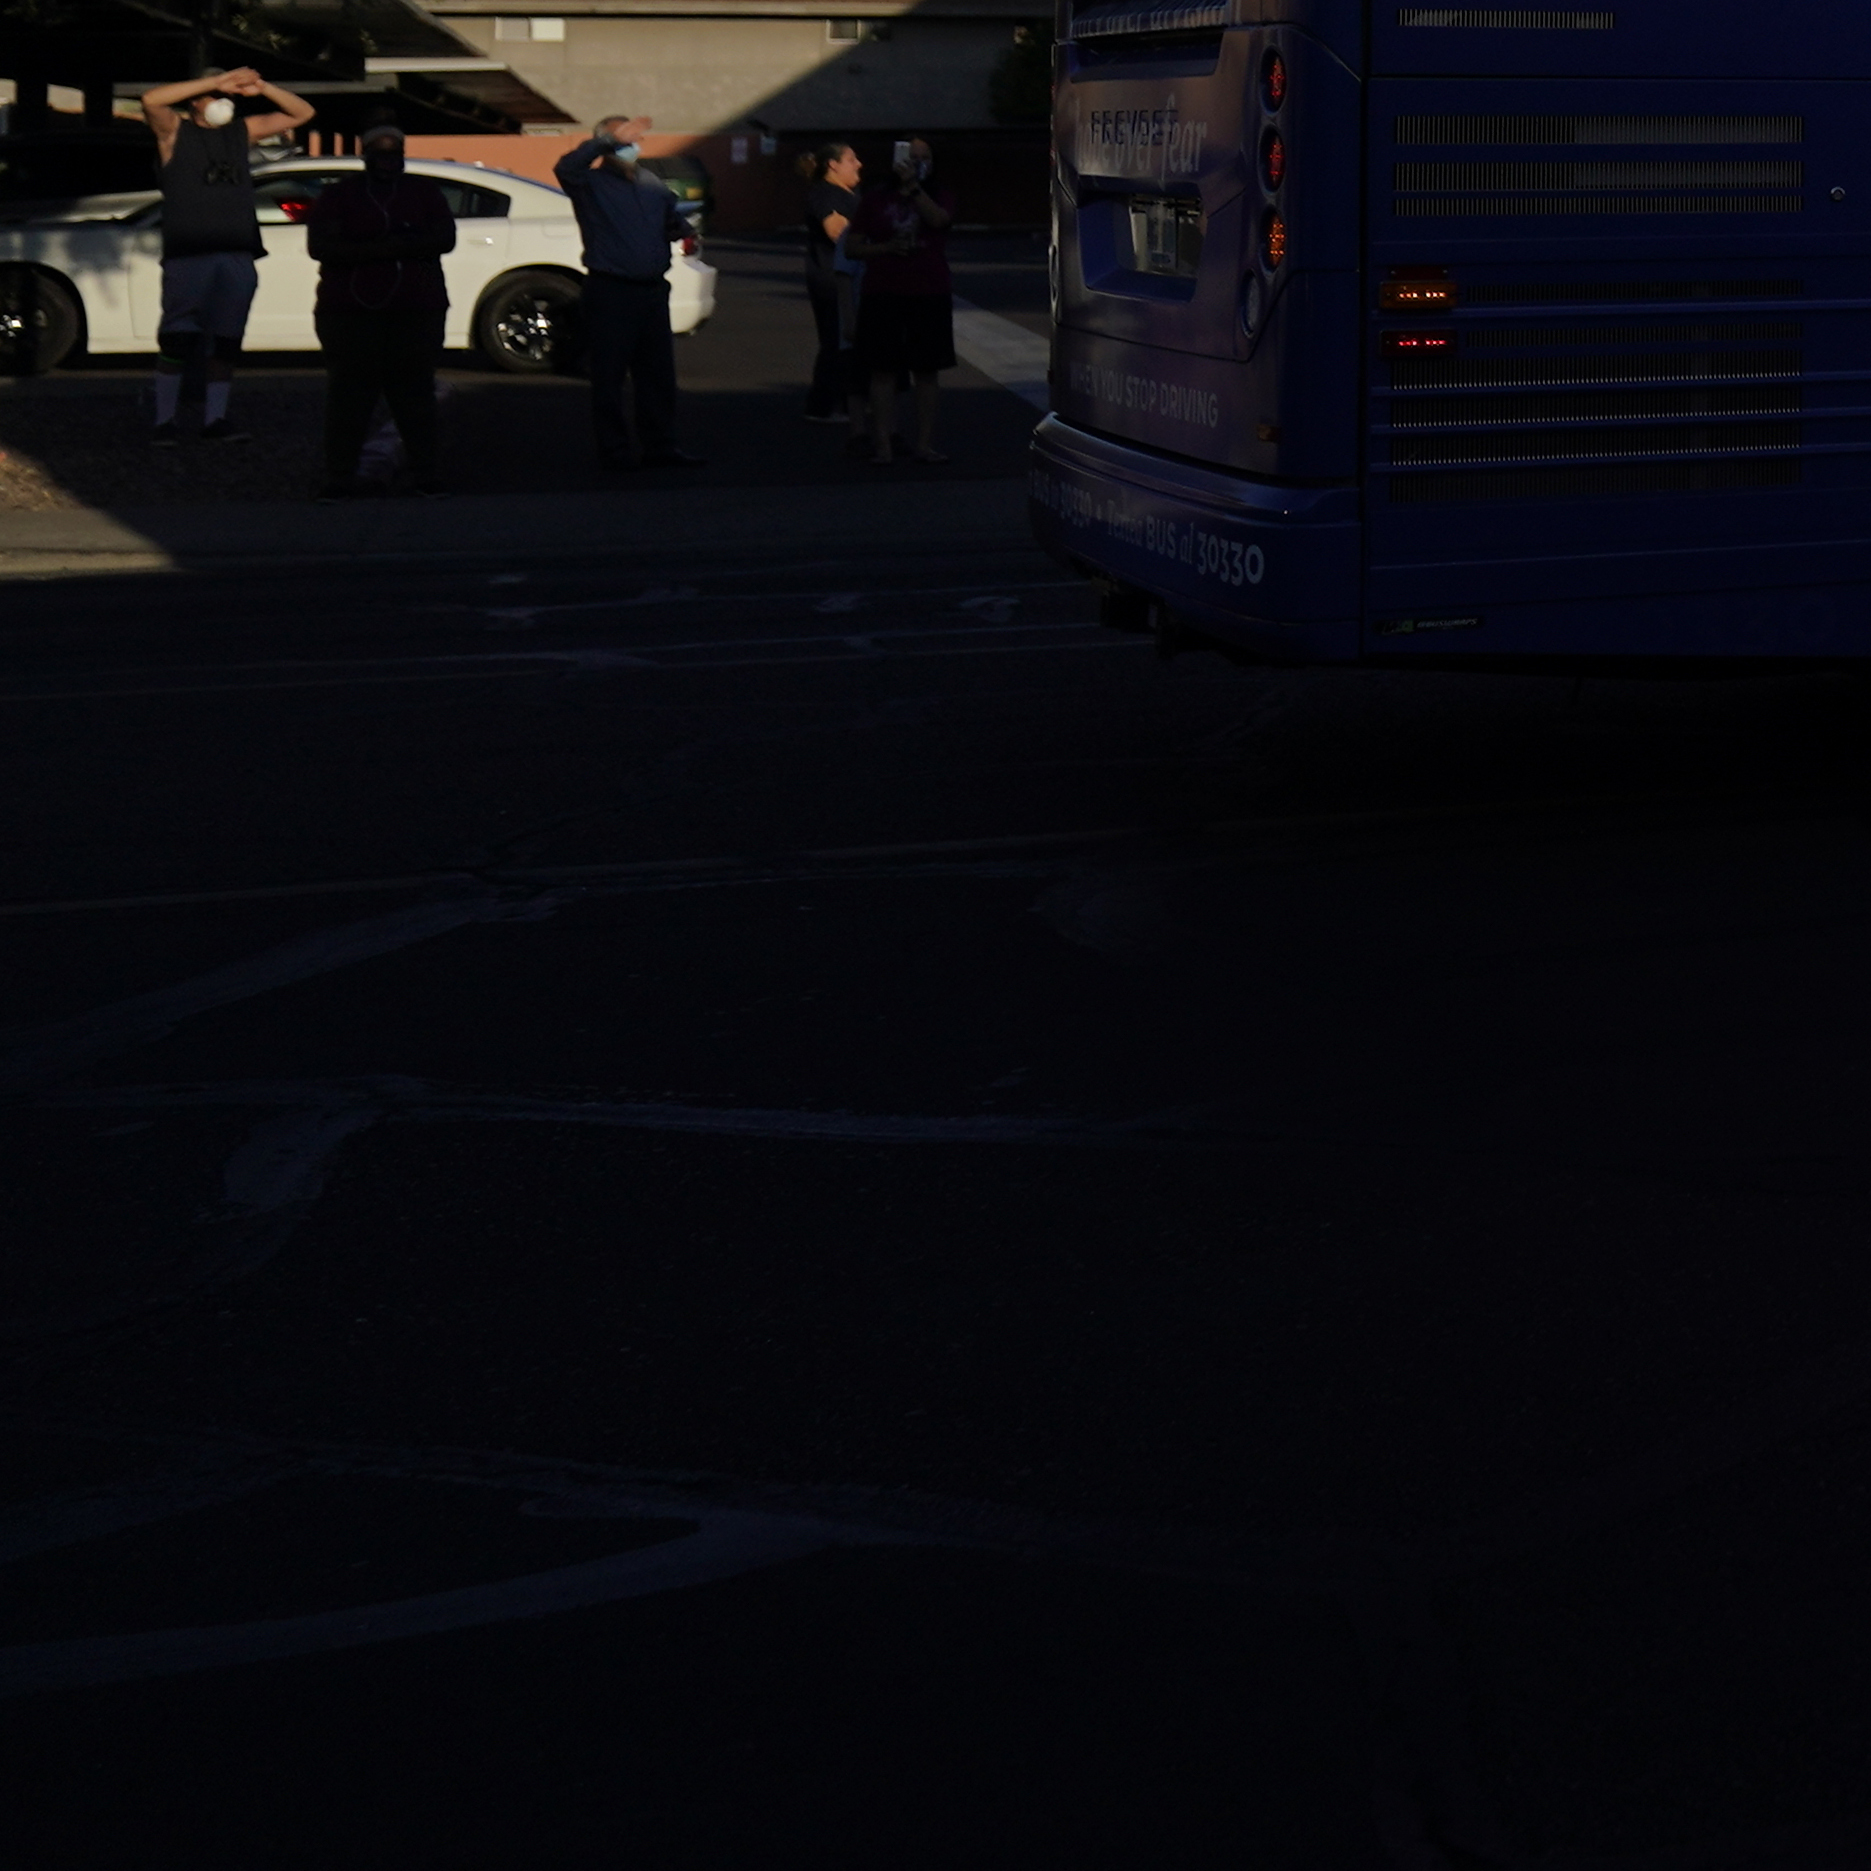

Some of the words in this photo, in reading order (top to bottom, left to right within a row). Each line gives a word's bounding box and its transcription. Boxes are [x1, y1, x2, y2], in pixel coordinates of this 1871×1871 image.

[1099, 366, 1124, 406] YOU
[1126, 374, 1157, 413] STOP
[1160, 381, 1219, 429] DRIVING
[1146, 514, 1177, 560] BUS
[1180, 521, 1196, 565] al
[1197, 530, 1266, 588] 30330
